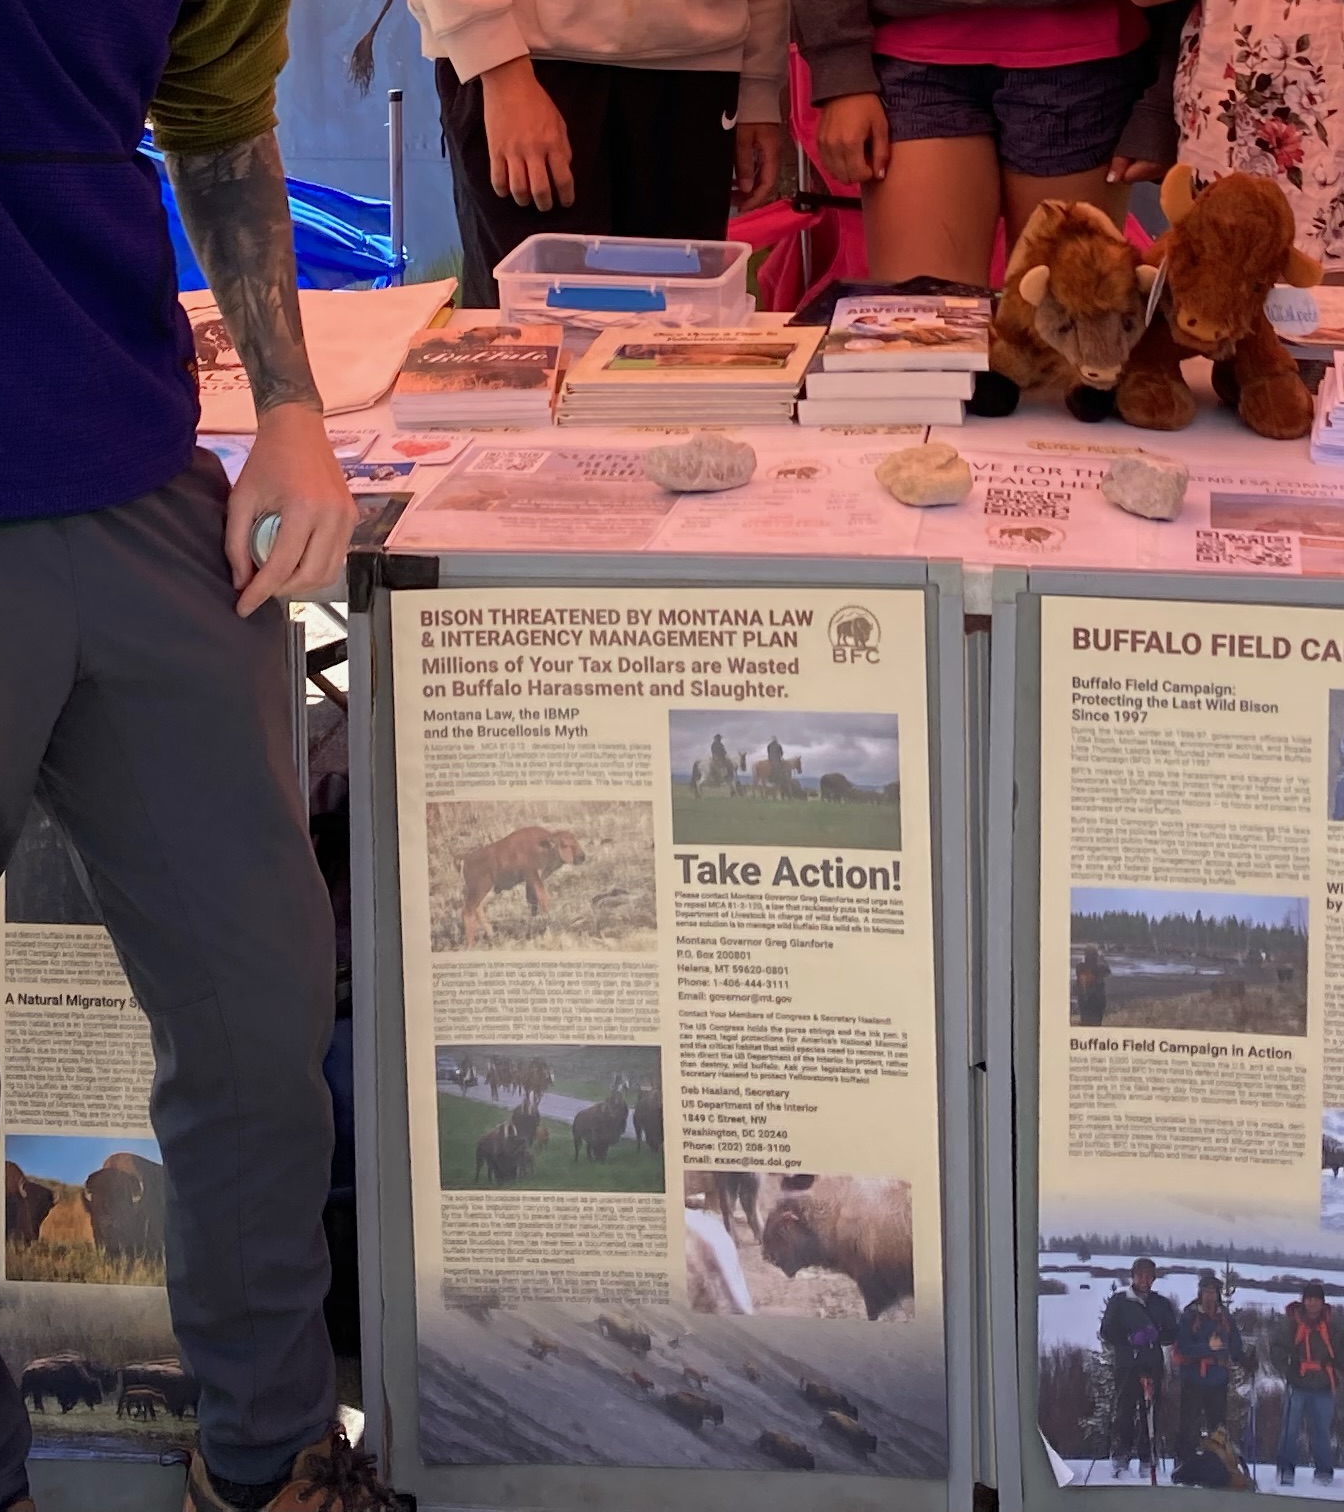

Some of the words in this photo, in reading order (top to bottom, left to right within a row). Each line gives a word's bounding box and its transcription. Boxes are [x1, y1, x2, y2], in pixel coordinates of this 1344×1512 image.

[420, 608, 482, 626] BISON
[487, 608, 620, 625] THREATENED
[626, 609, 651, 625] BY
[658, 609, 763, 626] MONTANA
[769, 609, 813, 626] LAW
[421, 631, 434, 647] &
[441, 629, 582, 647] INTERAGENCY
[589, 629, 737, 646] MANAGEMENT
[743, 630, 797, 647] PLAN
[1072, 626, 1201, 655] BUFFALO
[1211, 633, 1291, 659] FIELD
[832, 646, 880, 664] BFC
[422, 656, 498, 674] Millions
[504, 655, 523, 672] of
[529, 656, 573, 672] Your
[578, 656, 612, 672] Tax
[617, 655, 685, 673] Dollars
[691, 660, 721, 673] are
[727, 657, 799, 674] Wasted
[422, 684, 445, 697] on
[452, 680, 521, 696] Buffalo
[528, 681, 643, 696] Harassment
[649, 681, 684, 696] and
[690, 681, 787, 701] Slaughter.
[1071, 676, 1121, 690] Buffalo
[1125, 677, 1158, 692] Field
[1162, 679, 1235, 697] Campaign:
[1072, 693, 1142, 710] Protecting
[1146, 695, 1168, 707] the
[1172, 696, 1201, 709] Last
[1205, 698, 1235, 711] Wild
[1239, 700, 1278, 712] Bison
[423, 709, 481, 721] Montana
[485, 708, 515, 721] Law,
[518, 707, 539, 719] the
[544, 707, 579, 719] IBMP
[1071, 708, 1109, 721] Since
[1114, 710, 1147, 723] 1997
[424, 725, 448, 738] and
[451, 725, 473, 737] the
[477, 724, 550, 737] Brucellosis
[554, 724, 587, 739] Myth
[673, 852, 761, 885] Take
[771, 856, 900, 891] Action!
[1326, 898, 1342, 912] by
[5, 992, 15, 1005] A
[18, 993, 63, 1006] Natural
[66, 994, 126, 1010] Migratory
[1069, 1038, 1118, 1050] Buffalo
[1122, 1039, 1155, 1051] Field
[1158, 1040, 1227, 1057] Campaign
[1231, 1044, 1243, 1056] in
[1247, 1045, 1291, 1059] Action
